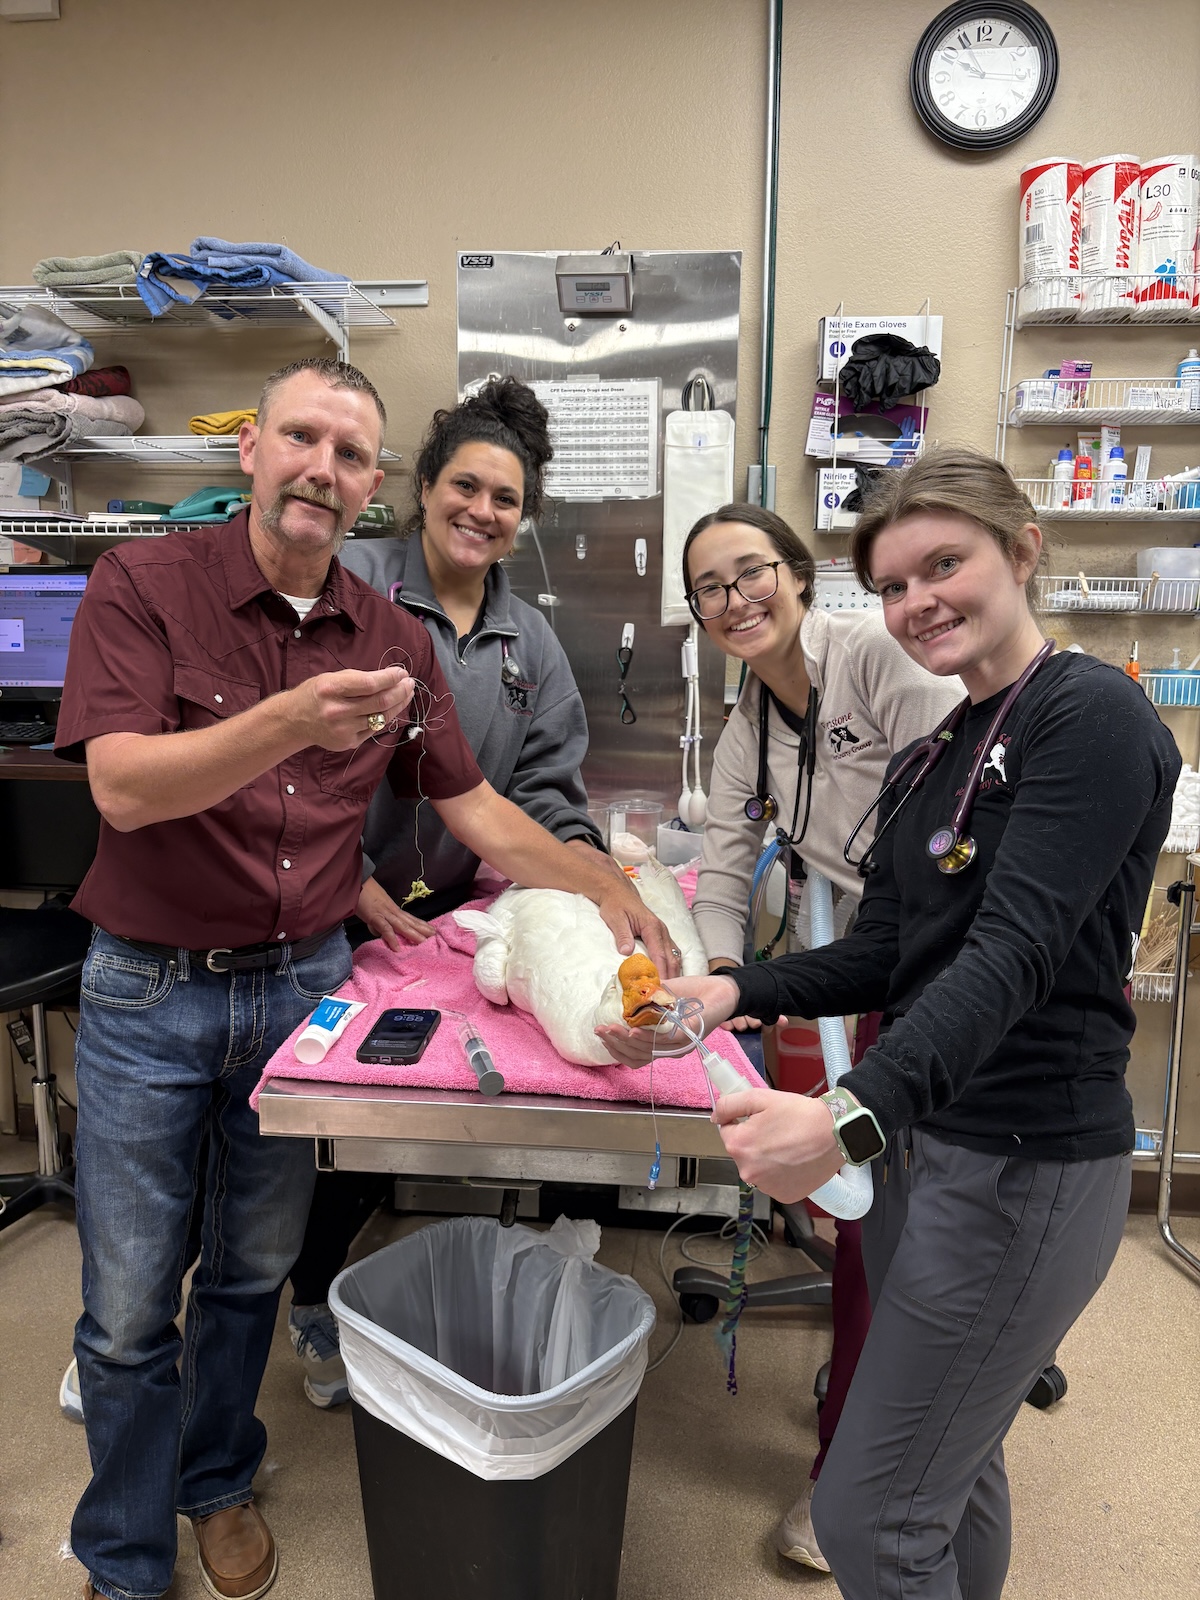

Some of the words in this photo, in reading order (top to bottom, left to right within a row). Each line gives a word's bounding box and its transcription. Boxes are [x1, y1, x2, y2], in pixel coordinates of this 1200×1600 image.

[976, 24, 993, 43] 12
[998, 31, 1010, 47] 1
[940, 46, 959, 66] 10
[1009, 45, 1027, 61] 2
[934, 70, 951, 85] 9
[1014, 68, 1031, 81] 3
[938, 90, 956, 107] 8
[1010, 89, 1026, 105] 4
[954, 104, 970, 120] 7
[974, 108, 987, 127] 6
[995, 102, 1008, 121] 5
[1034, 188, 1045, 196] L30
[1146, 183, 1171, 200] L30
[461, 256, 492, 265] VSSI
[855, 321, 877, 329] Exam
[879, 321, 907, 329] Gloves
[851, 740, 873, 753] Group
